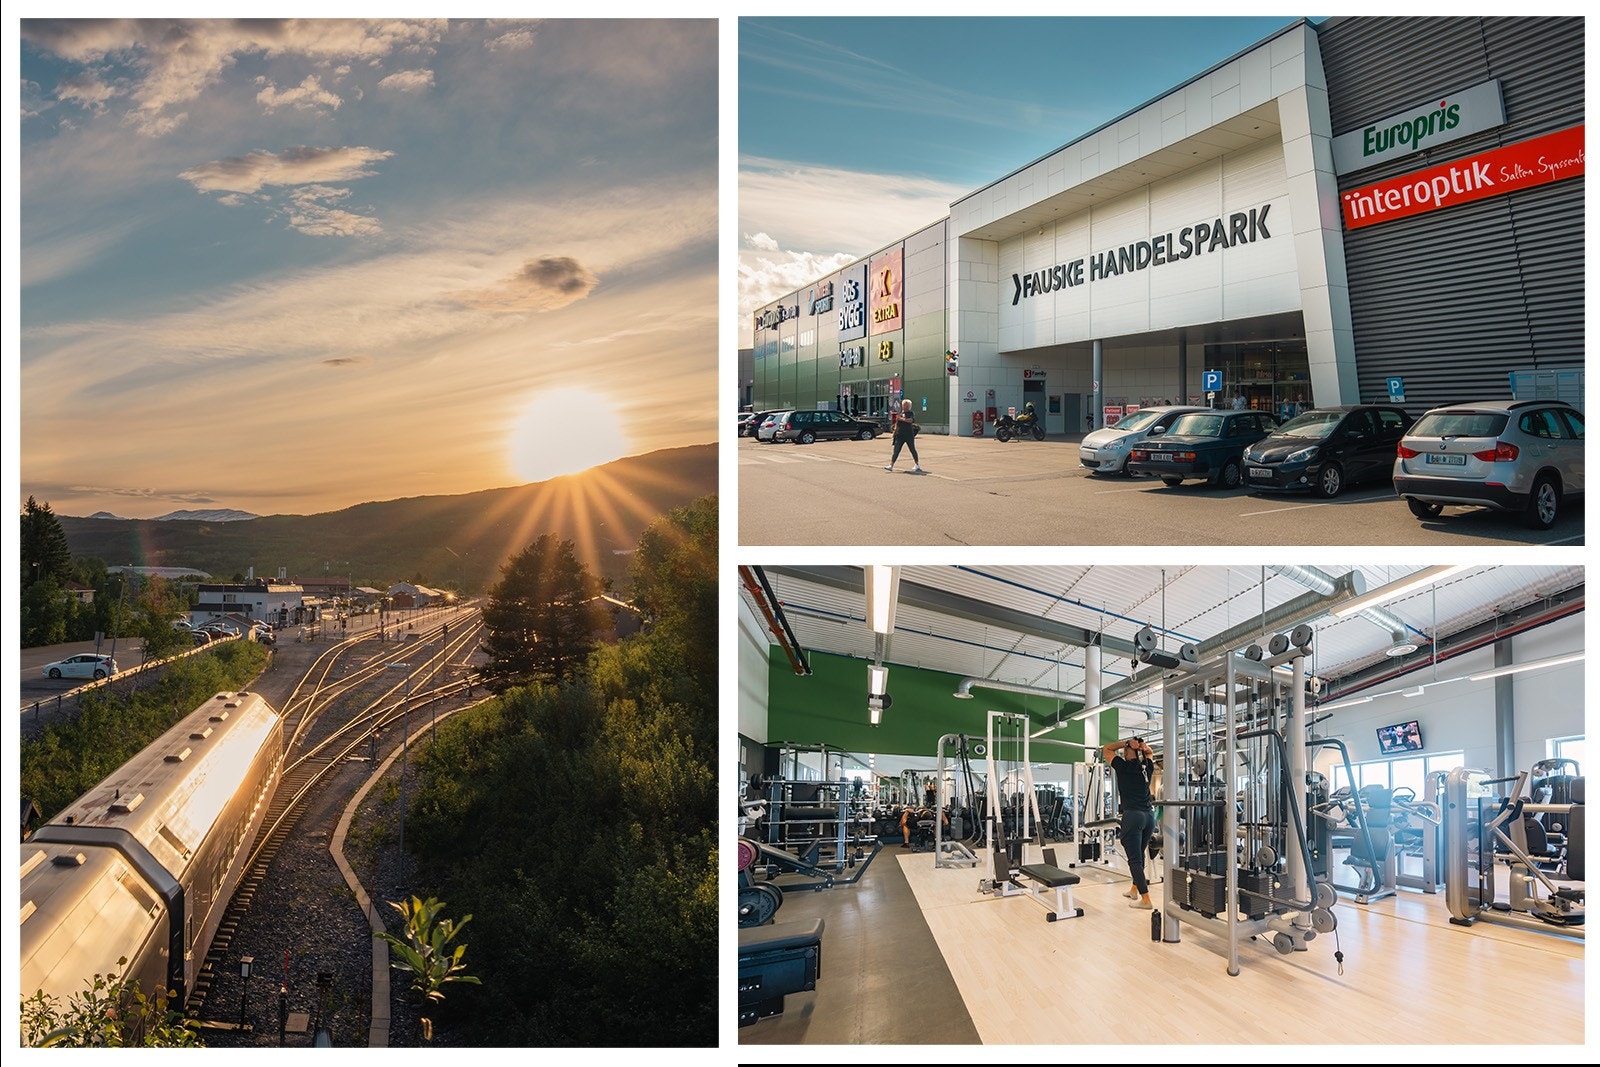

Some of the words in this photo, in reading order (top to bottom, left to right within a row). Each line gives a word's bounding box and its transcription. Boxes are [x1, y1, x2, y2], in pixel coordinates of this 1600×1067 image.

[1363, 101, 1460, 157] Europris
[1500, 164, 1534, 182] Salten
[1023, 258, 1084, 298] FAUSKE
[1090, 204, 1271, 281] HANDELSPARK
[838, 303, 862, 330] BYGG
[874, 303, 899, 323] EXTRA
[1207, 374, 1217, 388] P
[1391, 380, 1400, 393] P
